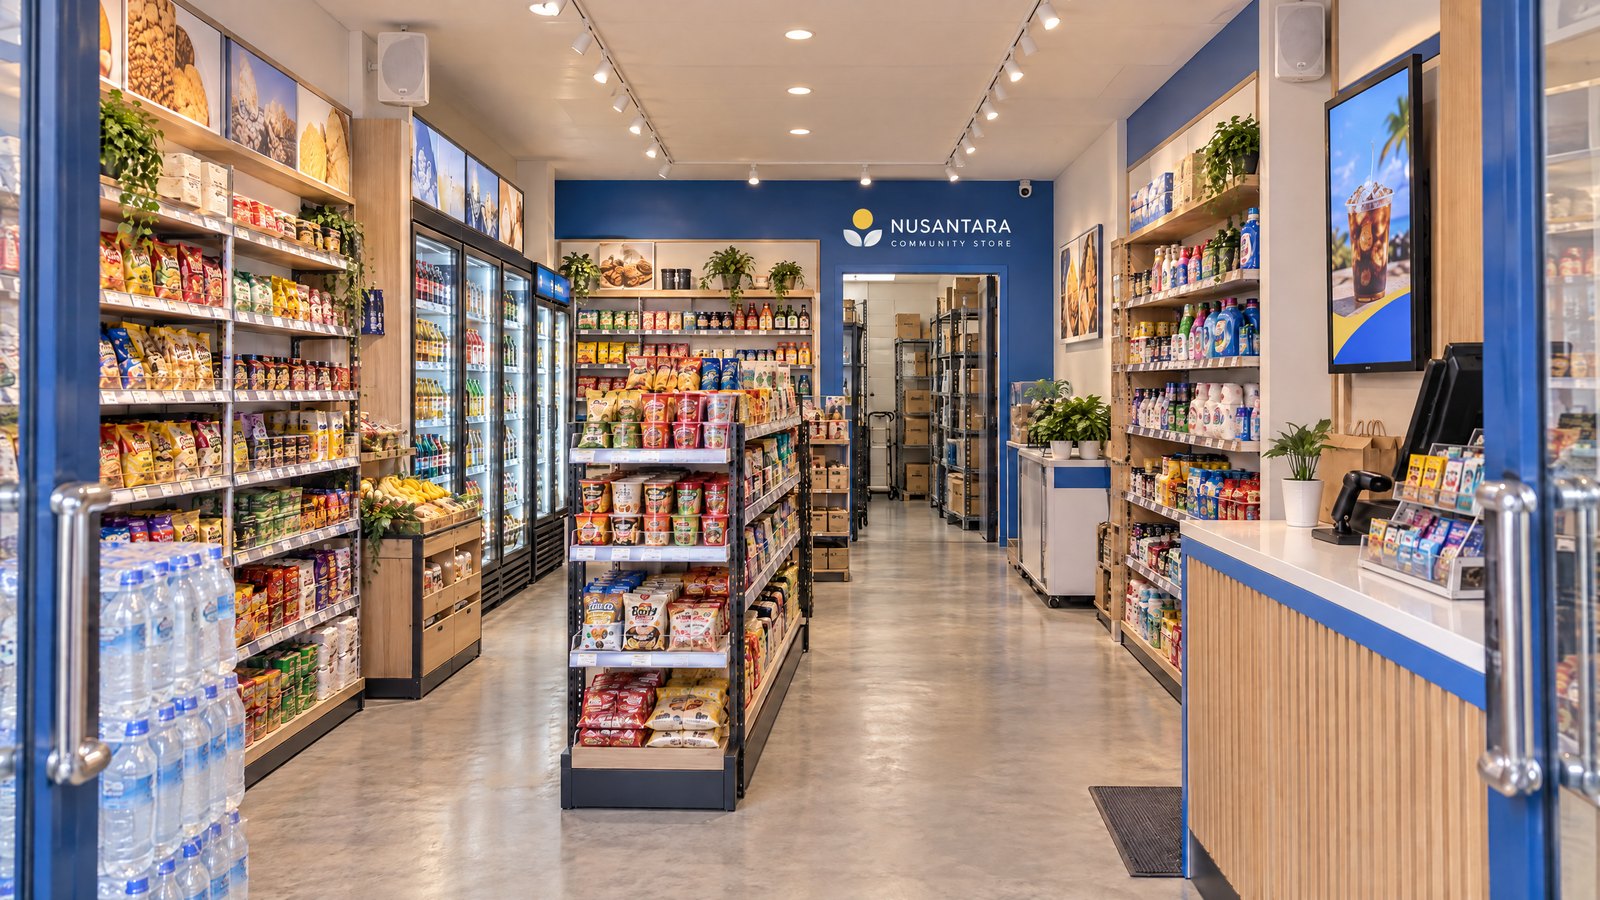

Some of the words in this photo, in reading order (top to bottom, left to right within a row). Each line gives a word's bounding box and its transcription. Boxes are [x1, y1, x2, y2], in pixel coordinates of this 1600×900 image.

[891, 219, 1011, 234] NUSANTARA
[891, 240, 965, 248] COMMUNITY
[973, 240, 1011, 248] STORE
